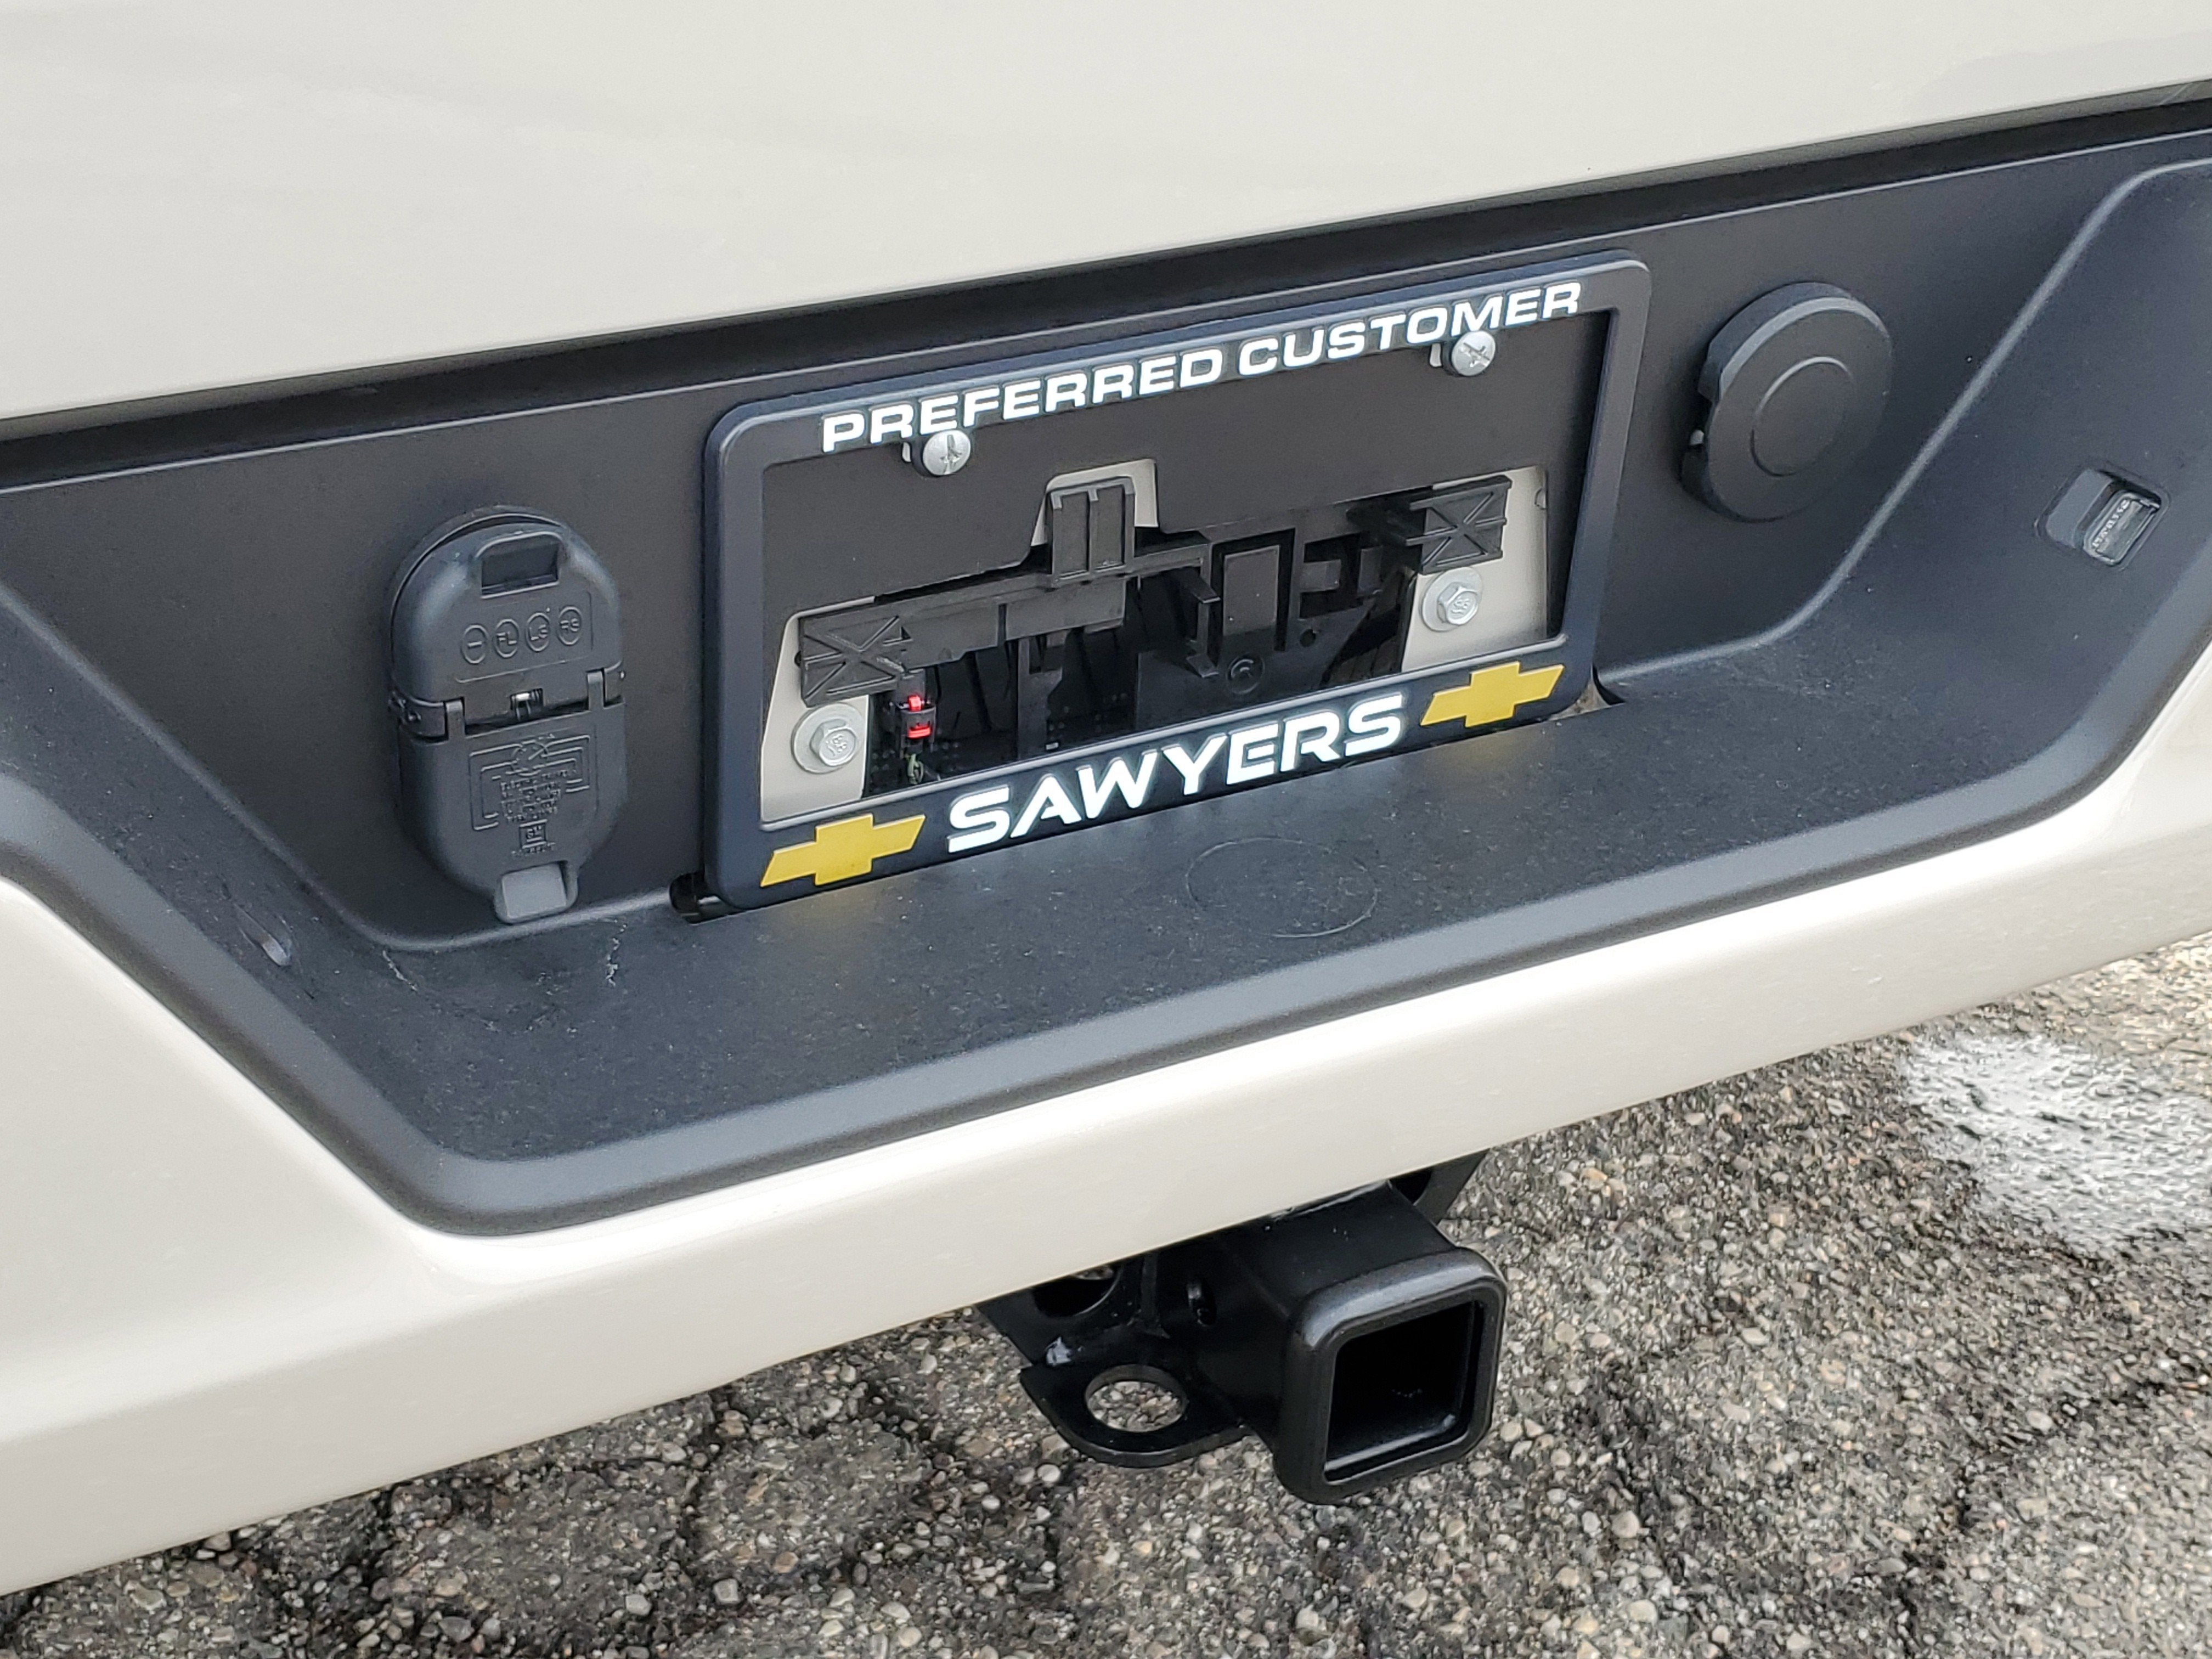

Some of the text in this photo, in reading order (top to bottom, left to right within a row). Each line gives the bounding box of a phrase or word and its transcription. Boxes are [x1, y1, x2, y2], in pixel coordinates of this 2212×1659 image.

[822, 281, 1582, 453] PREFERRED CUSTOMER
[948, 692, 1405, 854] SAWYERS
